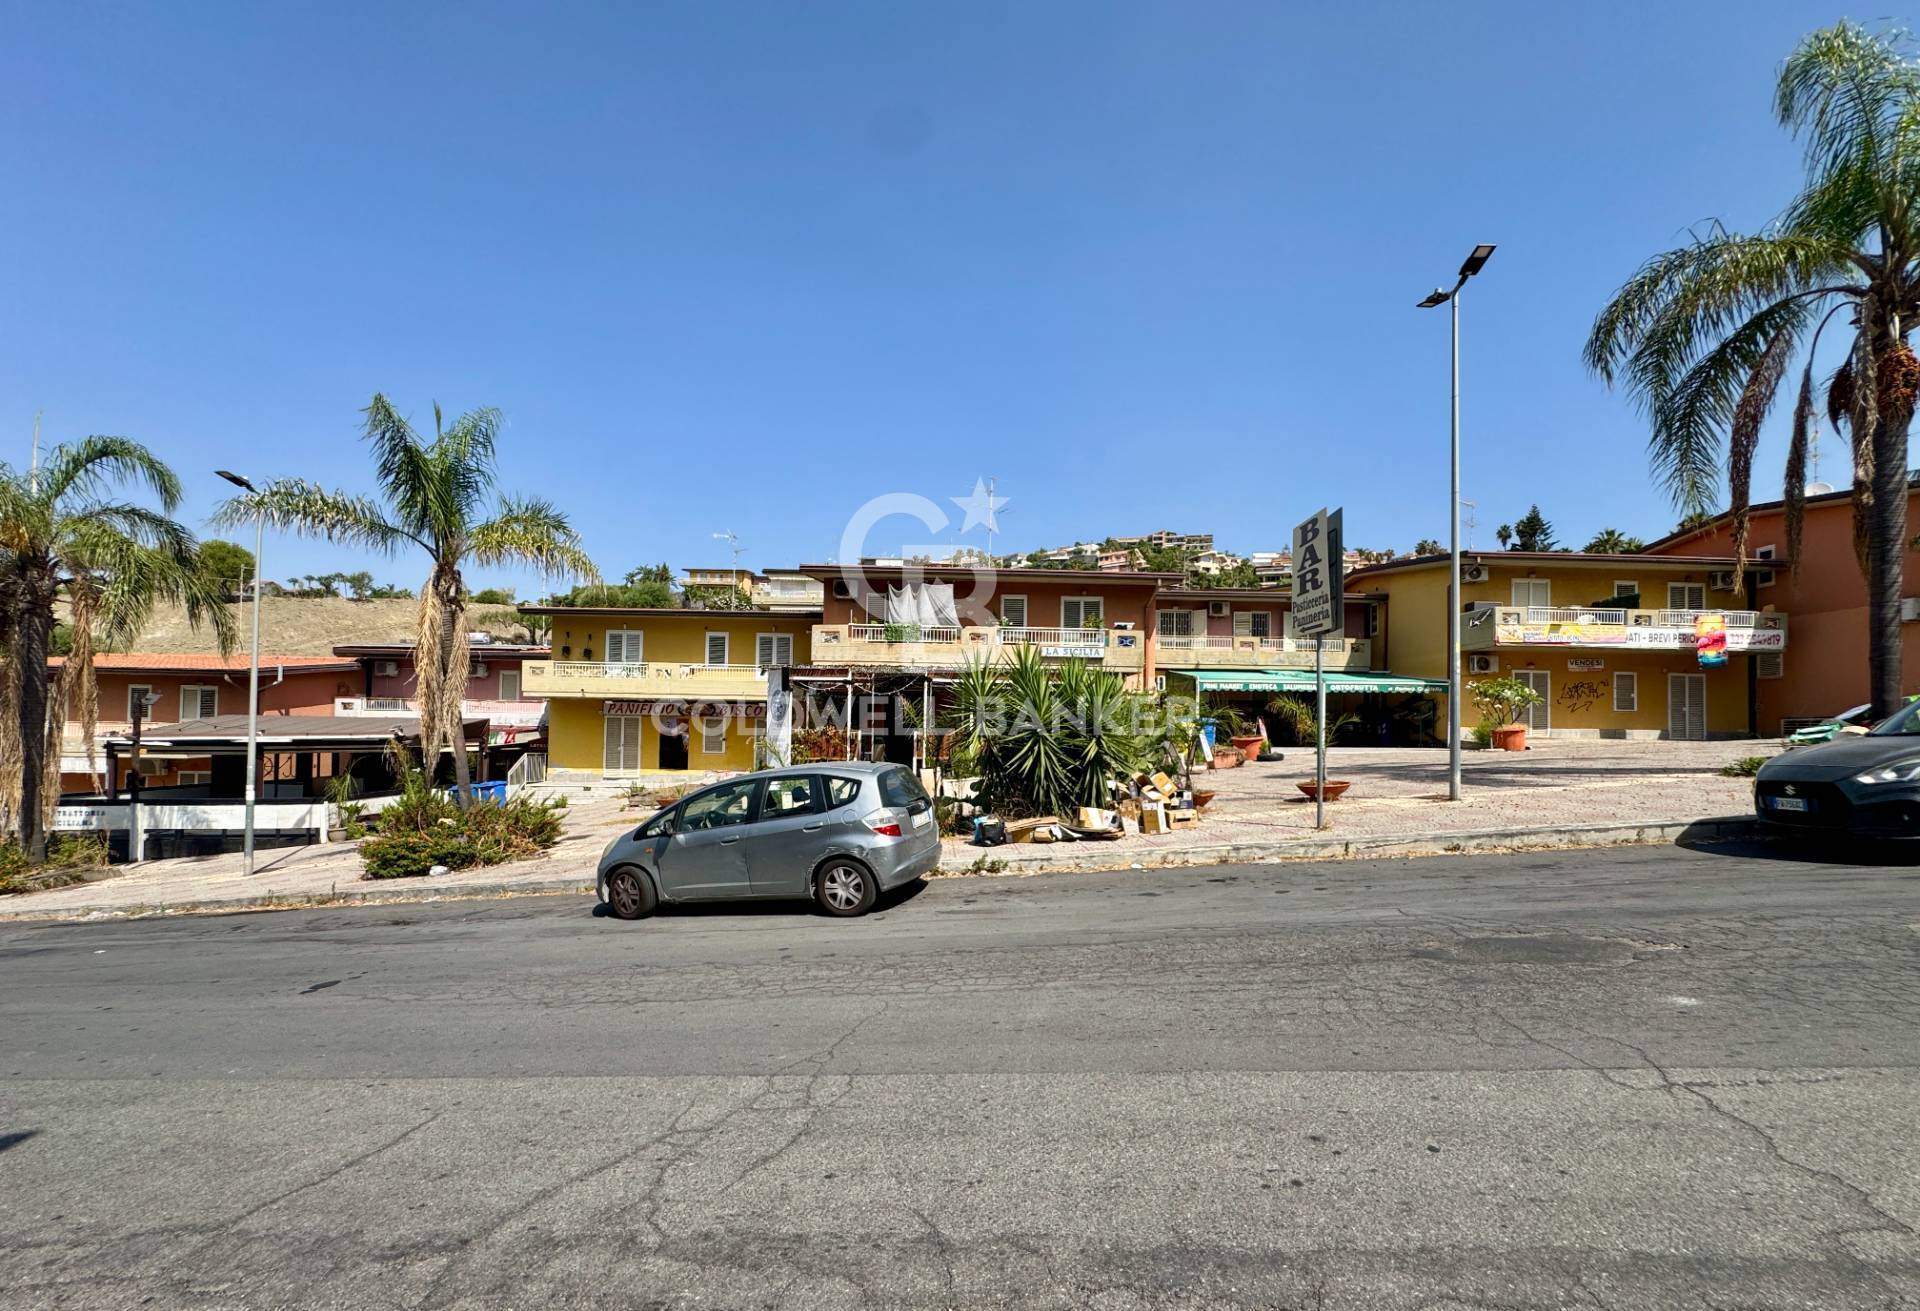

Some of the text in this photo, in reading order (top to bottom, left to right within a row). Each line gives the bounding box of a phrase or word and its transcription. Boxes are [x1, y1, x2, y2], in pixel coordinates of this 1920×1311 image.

[1297, 517, 1323, 597] BAR
[1292, 591, 1329, 615] Pasticceria
[1648, 633, 1671, 644] BREVI
[1063, 648, 1100, 656] SICILIA
[607, 703, 675, 714] PANIFICIO
